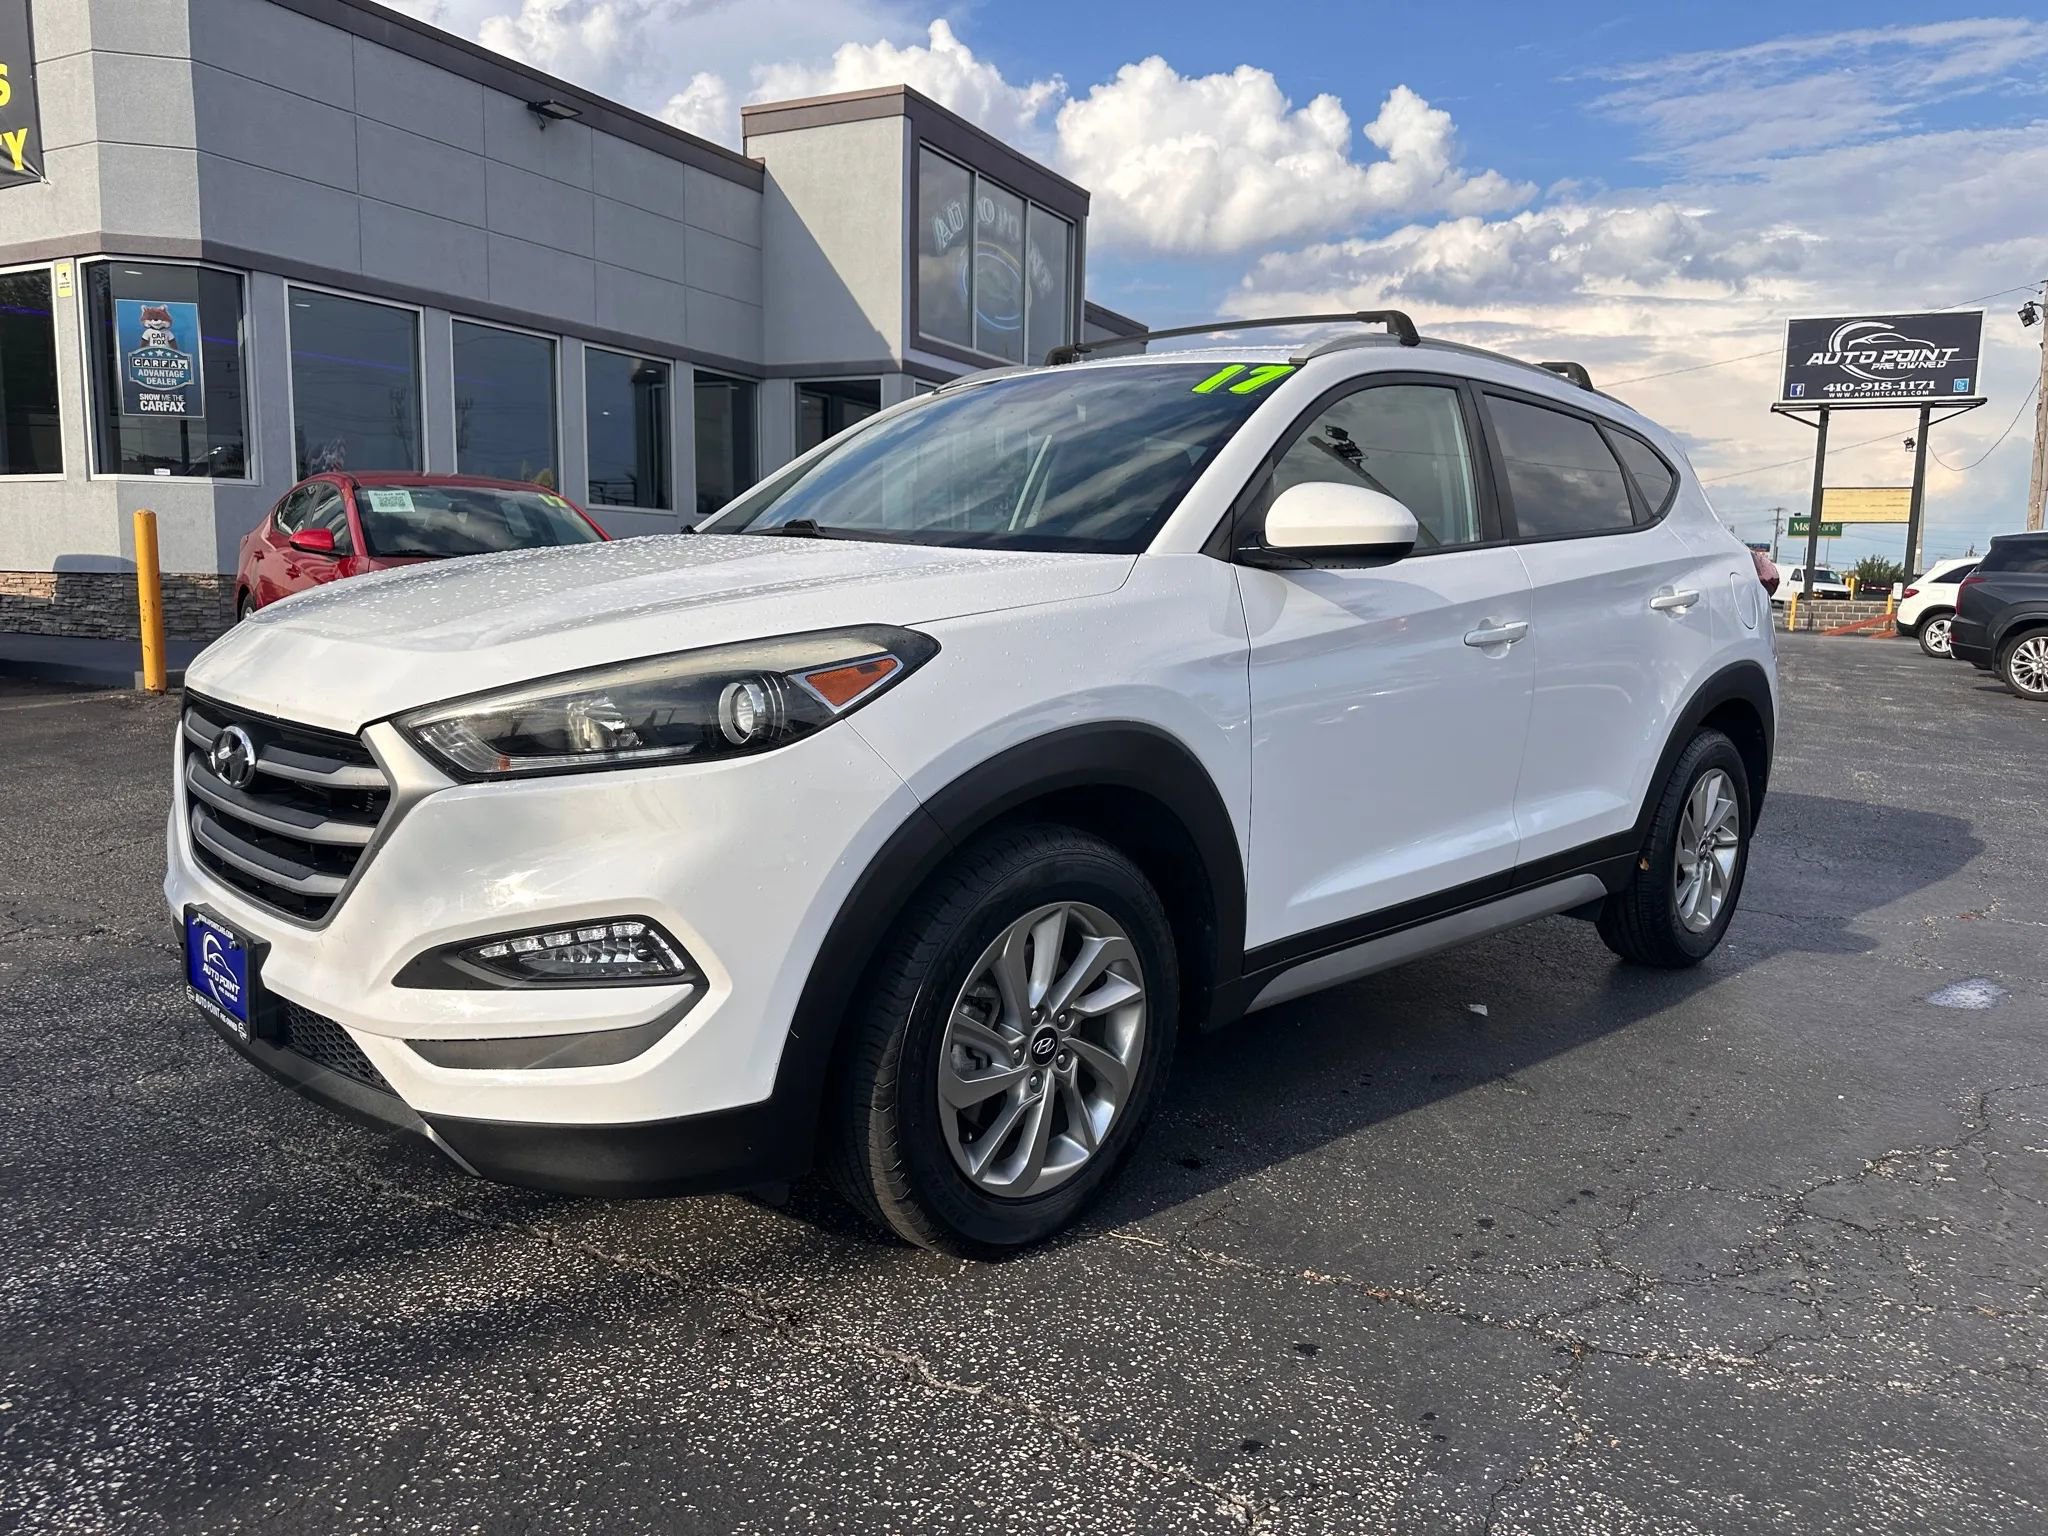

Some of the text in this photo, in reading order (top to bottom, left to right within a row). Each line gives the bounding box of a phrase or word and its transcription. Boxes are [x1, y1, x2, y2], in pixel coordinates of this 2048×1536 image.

[1806, 348, 1960, 366] AUTO POINT
[133, 358, 188, 369] CARFAX
[1871, 360, 1947, 370] PRE OWNED
[138, 368, 184, 378] ADVANTAGE
[146, 377, 177, 385] DEALER
[1191, 364, 1296, 395] 17
[1822, 380, 1936, 392] 410-918-1171
[139, 393, 161, 401] SHOW
[1829, 390, 1929, 398] WWW.APOINTCARS.COM
[140, 400, 186, 412] CARFAX
[1793, 522, 1810, 532] M&
[203, 962, 241, 995] AUTO POINT
